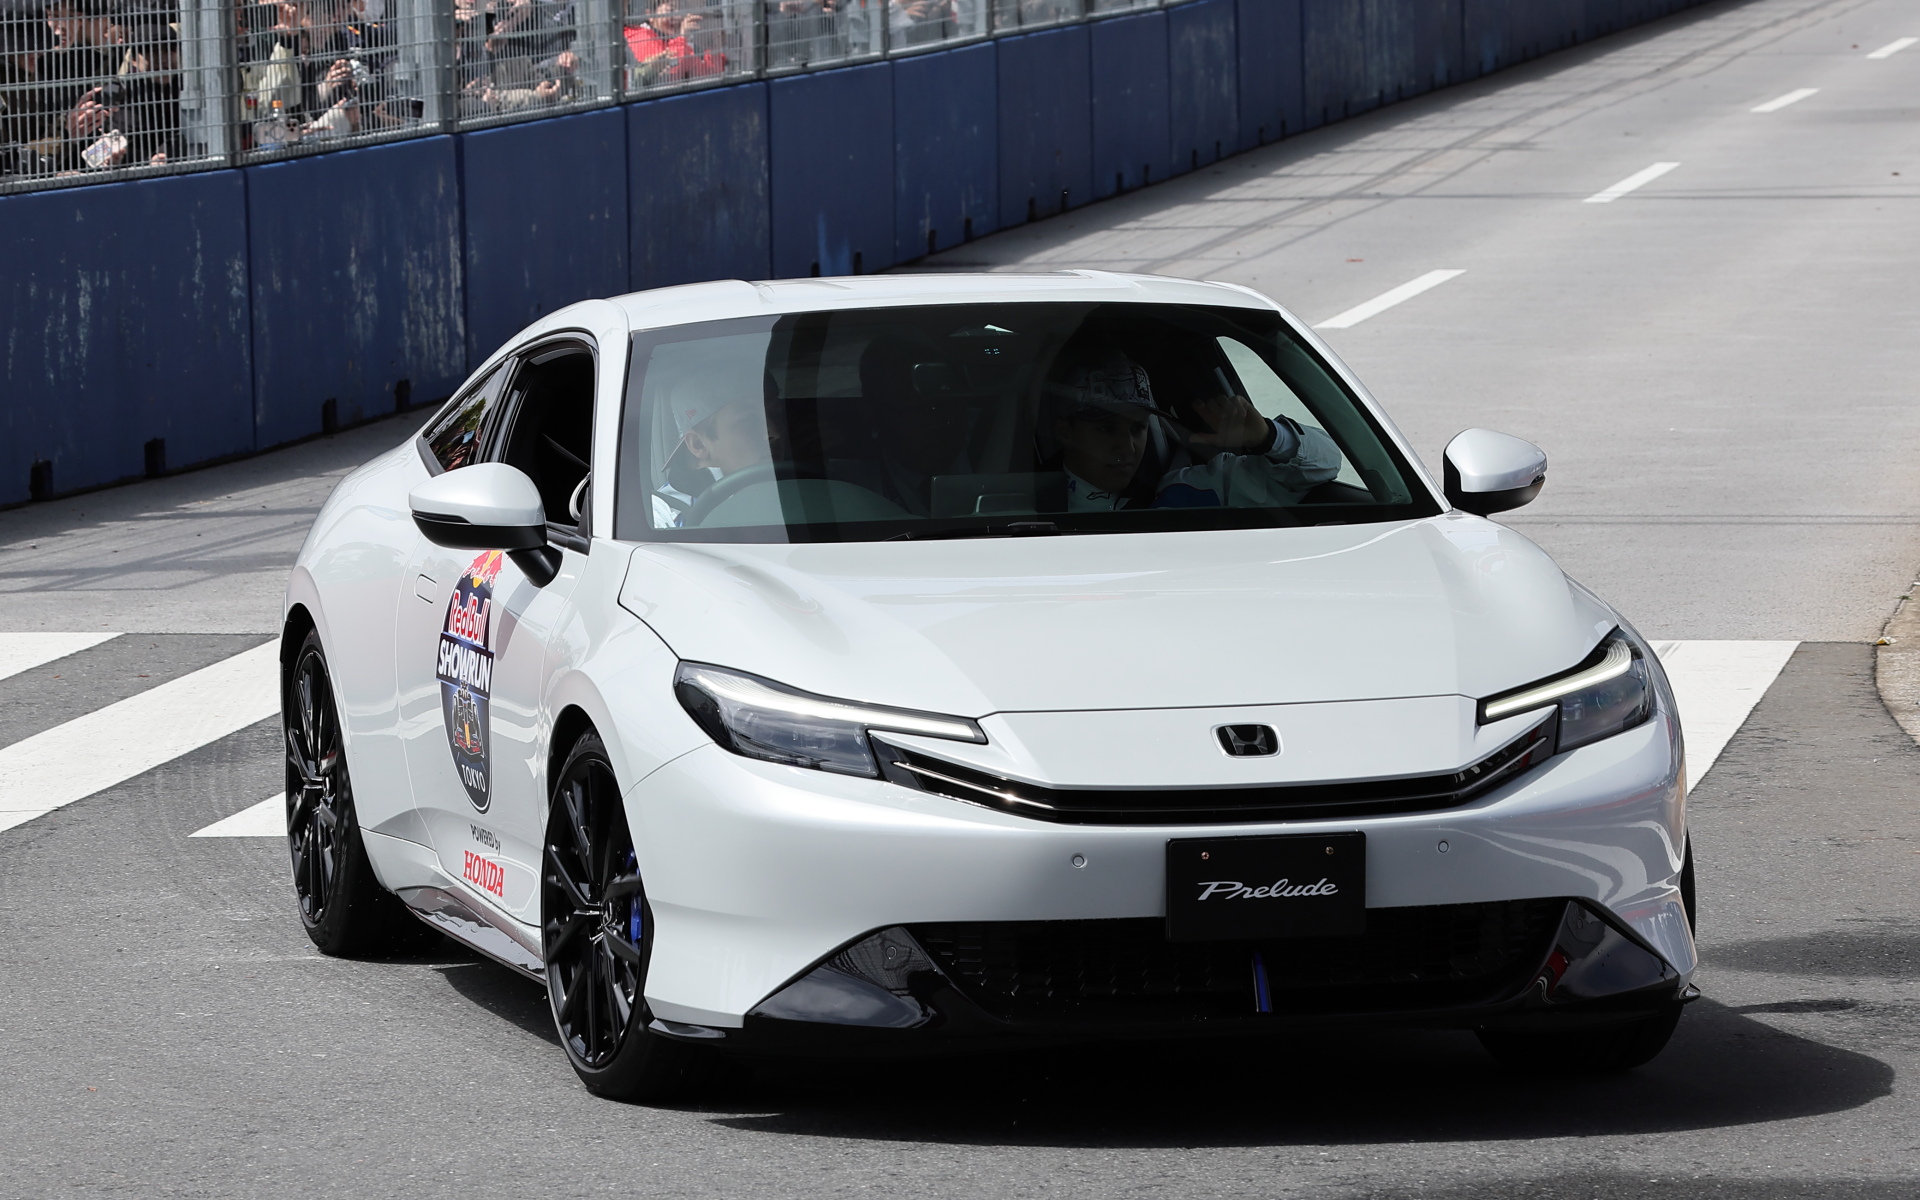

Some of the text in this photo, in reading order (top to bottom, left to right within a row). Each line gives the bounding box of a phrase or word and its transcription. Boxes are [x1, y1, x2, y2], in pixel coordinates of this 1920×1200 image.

[438, 638, 493, 693] SHOWRUN
[461, 764, 486, 793] TOKYO
[470, 823, 501, 857] POWERED by
[463, 849, 505, 898] HONDA
[1198, 878, 1338, 901] Prelude
